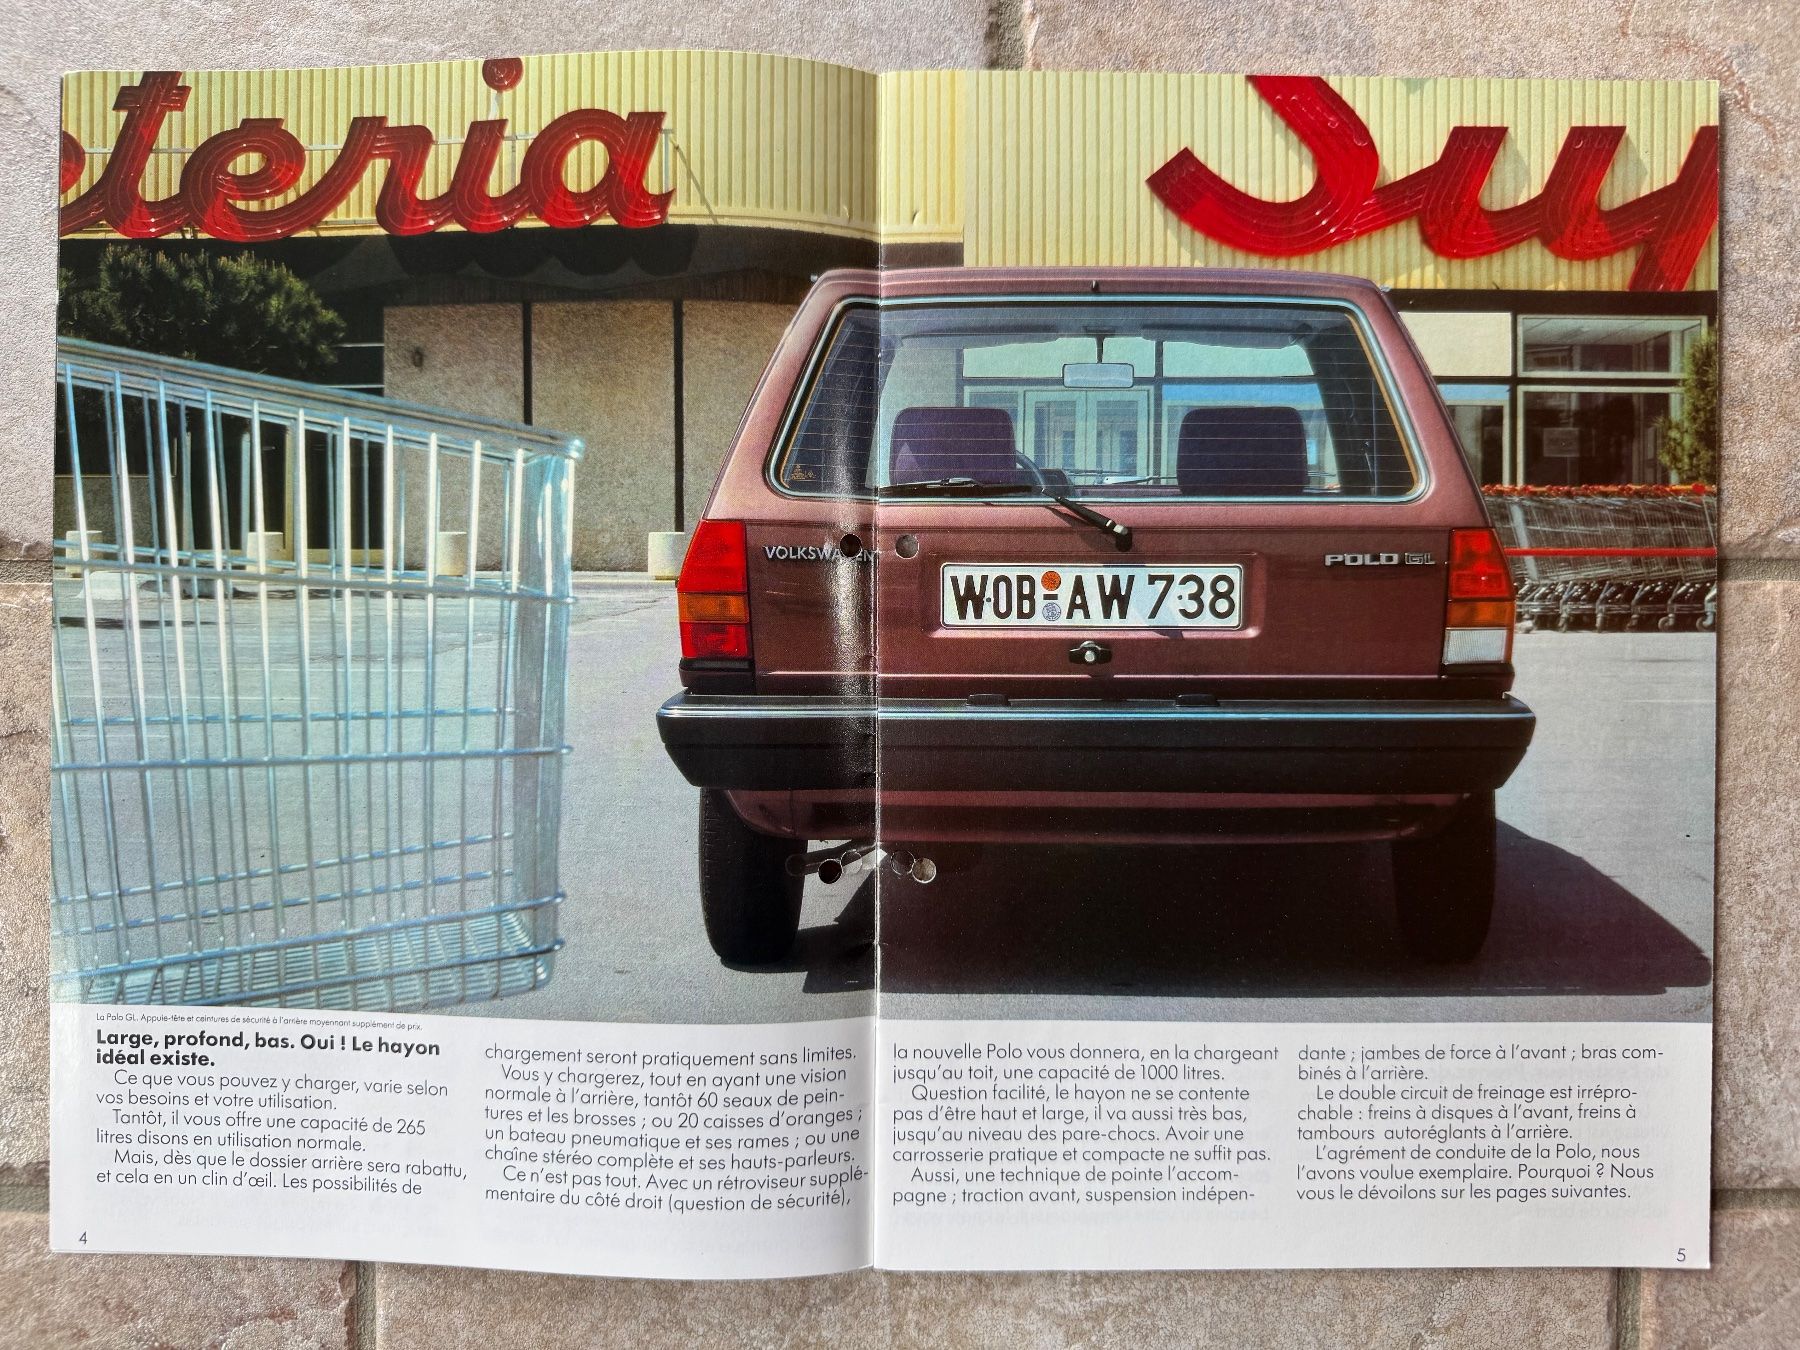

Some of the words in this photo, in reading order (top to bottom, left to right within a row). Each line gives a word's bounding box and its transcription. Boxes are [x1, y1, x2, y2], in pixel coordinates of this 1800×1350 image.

[60, 57, 676, 242] teria
[764, 545, 875, 562] VOLKSWAN
[1324, 553, 1400, 566] POLO
[1404, 552, 1436, 565] GL
[1147, 573, 1236, 620] 738
[97, 1029, 159, 1049] Large,
[164, 1030, 250, 1051] profond,
[255, 1031, 295, 1049] bas.
[300, 1033, 334, 1050] Oui
[352, 1036, 373, 1052] Le
[378, 1036, 440, 1058] hayon
[894, 1043, 908, 1059] la
[913, 1042, 982, 1060] nouvelle
[987, 1042, 1023, 1059] Polo
[1026, 1048, 1065, 1059] vous
[1070, 1042, 1145, 1062] donnera,
[1150, 1049, 1169, 1060] en
[1175, 1044, 1189, 1060] la
[1194, 1044, 1279, 1065] chargeant
[96, 1048, 145, 1065] idéal
[149, 1049, 215, 1067] existe.
[485, 1042, 582, 1065] chargement
[586, 1051, 637, 1065] seront
[642, 1051, 755, 1071] pratiquement
[759, 1053, 798, 1066] sans
[803, 1046, 856, 1063] limites.
[114, 1069, 138, 1085] Ce
[142, 1074, 173, 1090] que
[177, 1075, 215, 1087] vous
[220, 1076, 278, 1091] pouvez
[281, 1078, 291, 1093] y
[295, 1073, 359, 1095] charger,
[364, 1079, 402, 1094] varie
[407, 1080, 448, 1096] selon
[893, 1064, 963, 1084] jusqu'au
[968, 1065, 998, 1082] toit,
[1003, 1068, 1033, 1079] une
[1038, 1064, 1110, 1084] capacité
[1114, 1063, 1136, 1080] de
[1140, 1064, 1178, 1080] 1000
[1183, 1063, 1224, 1080] litres.
[96, 1093, 124, 1105] vos
[128, 1088, 190, 1106] besoins
[194, 1092, 209, 1106] et
[213, 1093, 254, 1108] votre
[258, 1092, 337, 1110] utilisation.
[485, 1085, 551, 1103] normale
[556, 1088, 566, 1103] à
[571, 1087, 639, 1109] l'arrière,
[644, 1092, 693, 1108] tantôt
[697, 1091, 718, 1108] 60
[723, 1096, 772, 1108] seaux
[777, 1089, 799, 1106] de
[803, 1088, 844, 1109] pein-
[911, 1084, 987, 1101] Question
[992, 1083, 1050, 1102] facilité,
[1055, 1083, 1069, 1100] le
[1074, 1083, 1125, 1104] hayon
[1131, 1089, 1151, 1100] ne
[1155, 1089, 1174, 1100] se
[1178, 1087, 1250, 1101] contente
[1317, 1085, 1334, 1100] Le
[1338, 1083, 1396, 1100] double
[1400, 1085, 1448, 1100] circuit
[1452, 1084, 1473, 1100] de
[1477, 1083, 1545, 1104] freinage
[1549, 1085, 1573, 1099] est
[1577, 1084, 1637, 1103] irrépro-
[112, 1108, 166, 1128] Tantôt,
[171, 1109, 179, 1125] il
[183, 1115, 221, 1127] vous
[225, 1110, 262, 1128] offre
[266, 1117, 296, 1129] une
[300, 1117, 368, 1133] capacité
[372, 1117, 392, 1134] de
[397, 1118, 426, 1136] 265
[97, 1128, 133, 1144] litres
[137, 1128, 189, 1145] disons
[193, 1135, 212, 1146] en
[217, 1130, 292, 1148] utilisation
[297, 1135, 366, 1152] normale.
[1297, 1123, 1375, 1140] tambours
[1384, 1123, 1486, 1144] autoréglants
[1491, 1124, 1501, 1139] à
[1507, 1123, 1572, 1139] l'arrière.
[485, 1144, 538, 1163] chaîne
[542, 1149, 593, 1166] stéréo
[597, 1152, 674, 1172] complète
[678, 1156, 694, 1170] et
[699, 1159, 726, 1170] ses
[731, 1149, 855, 1172] hauts-parleurs.
[892, 1147, 984, 1162] carrosserie
[989, 1147, 1058, 1166] pratique
[1062, 1147, 1078, 1161] et
[1082, 1147, 1165, 1165] compacte
[1170, 1150, 1189, 1161] ne
[1194, 1144, 1232, 1161] suffit
[1237, 1150, 1270, 1165] pas.
[1316, 1144, 1406, 1165] L'agrément
[1410, 1143, 1431, 1160] de
[1435, 1143, 1506, 1159] conduite
[1510, 1143, 1532, 1159] de
[1536, 1142, 1550, 1159] la
[1556, 1142, 1596, 1161] Polo,
[1601, 1148, 1640, 1159] nous
[910, 1166, 959, 1185] Aussi,
[965, 1171, 995, 1182] une
[1000, 1165, 1080, 1186] technique
[1085, 1165, 1106, 1182] de
[1111, 1167, 1163, 1185] pointe
[1297, 1163, 1355, 1180] l'avons
[1359, 1163, 1414, 1180] voulue
[1418, 1162, 1512, 1183] exemplaire.
[1518, 1163, 1590, 1183] Pourquoi
[1610, 1163, 1654, 1179] Nous
[485, 1188, 555, 1204] mentaire
[560, 1188, 580, 1206] du
[585, 1191, 620, 1208] côté
[625, 1192, 663, 1209] droit
[668, 1193, 745, 1215] (question
[750, 1193, 772, 1210] de
[777, 1187, 850, 1209] sécurité),
[1296, 1189, 1335, 1200] vous
[1340, 1183, 1353, 1200] le
[1358, 1183, 1436, 1200] dévoilons
[1441, 1188, 1465, 1199] sur
[1470, 1183, 1491, 1199] les
[1496, 1188, 1547, 1203] pages
[1551, 1184, 1631, 1198] suivantes.
[78, 1231, 88, 1245] 4
[1676, 1248, 1686, 1262] 5
